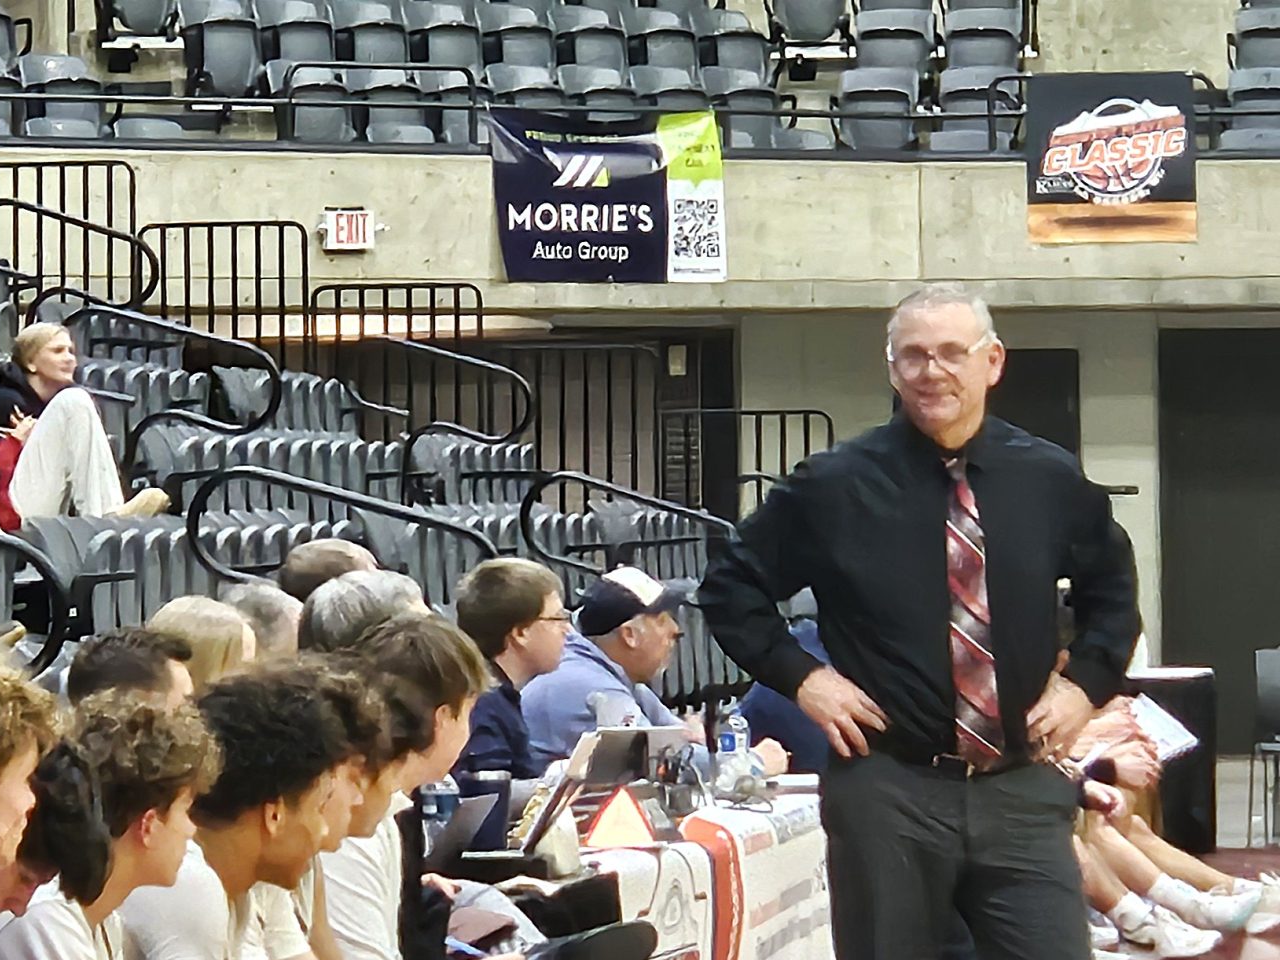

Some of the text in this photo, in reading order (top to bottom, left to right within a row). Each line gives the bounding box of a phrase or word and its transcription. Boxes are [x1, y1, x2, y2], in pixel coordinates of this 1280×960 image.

[1043, 127, 1187, 175] CLASSIC
[335, 213, 369, 243] EXIT
[507, 203, 654, 233] MORRIE'S
[531, 241, 629, 262] Auto Group
